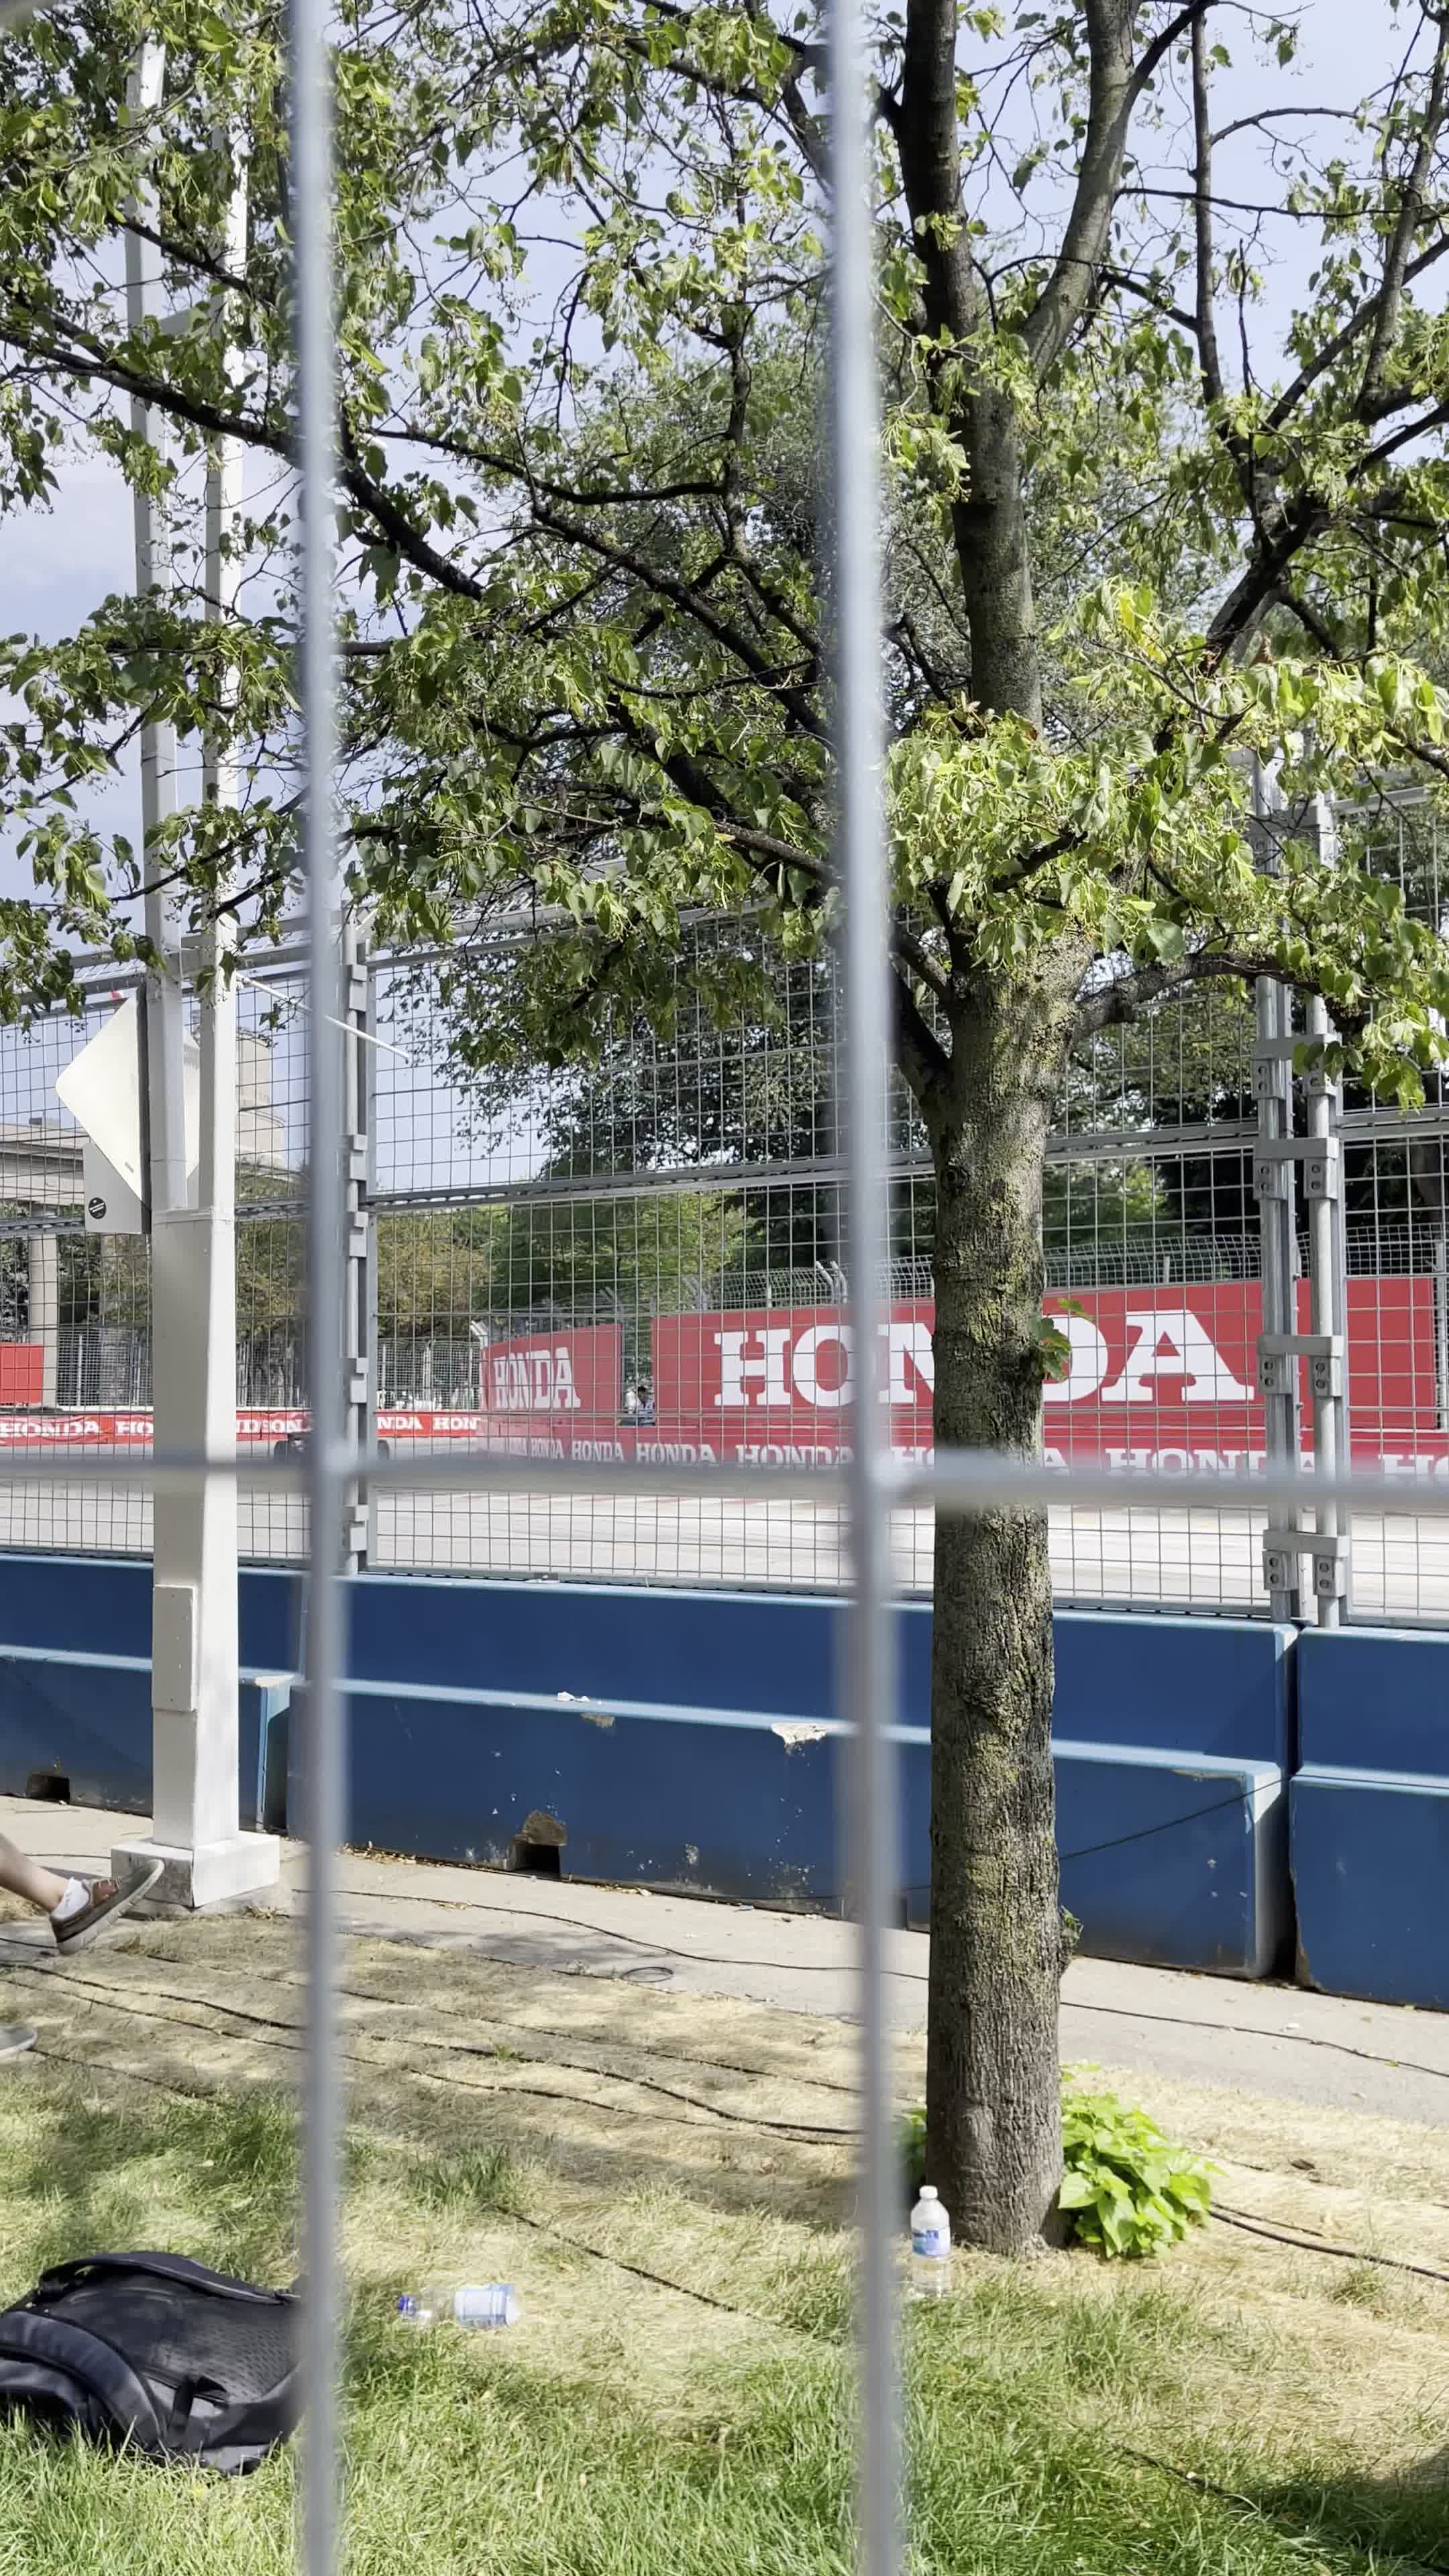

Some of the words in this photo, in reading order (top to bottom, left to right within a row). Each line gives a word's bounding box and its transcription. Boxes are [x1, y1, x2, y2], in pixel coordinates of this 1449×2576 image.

[493, 1347, 581, 1409] HONDA
[0, 1420, 100, 1438] HONDA
[531, 1438, 565, 1460] HONDA
[571, 1440, 624, 1462] HONDA
[635, 1443, 720, 1467] HONDA
